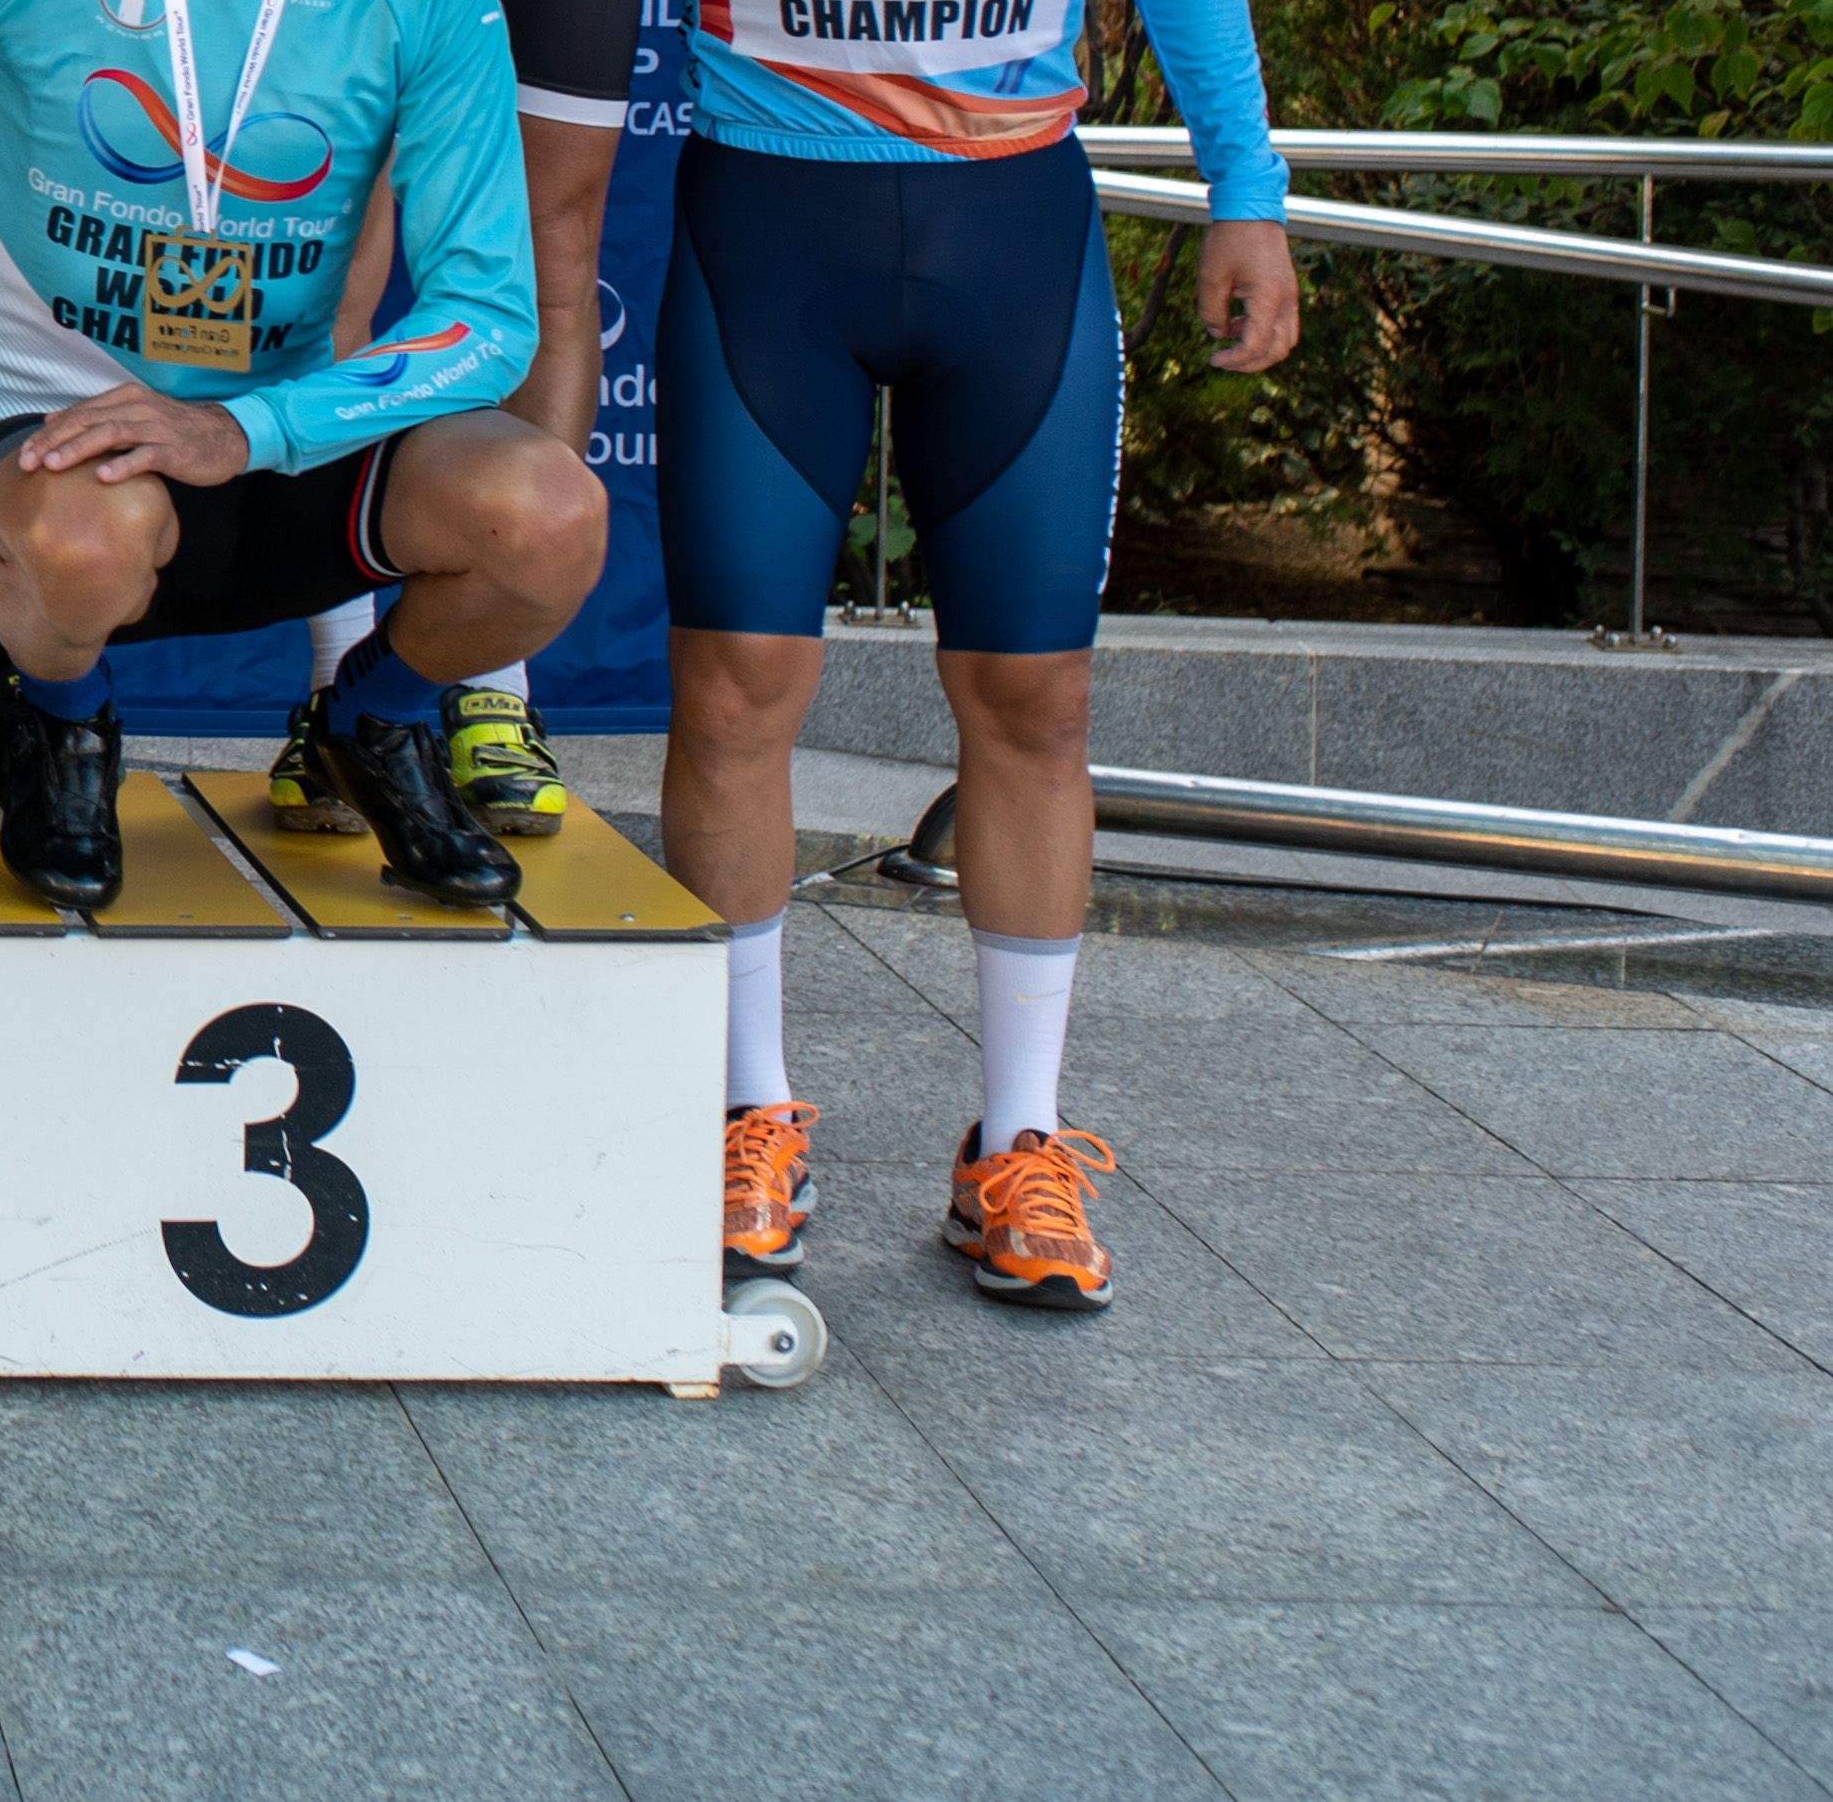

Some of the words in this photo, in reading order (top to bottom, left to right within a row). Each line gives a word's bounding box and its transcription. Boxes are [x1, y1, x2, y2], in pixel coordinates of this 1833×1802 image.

[628, 102, 691, 136] CAS
[27, 166, 85, 206] Gran
[92, 190, 183, 229] Fondo
[217, 214, 275, 240] orld
[160, 1003, 370, 1318] 3
